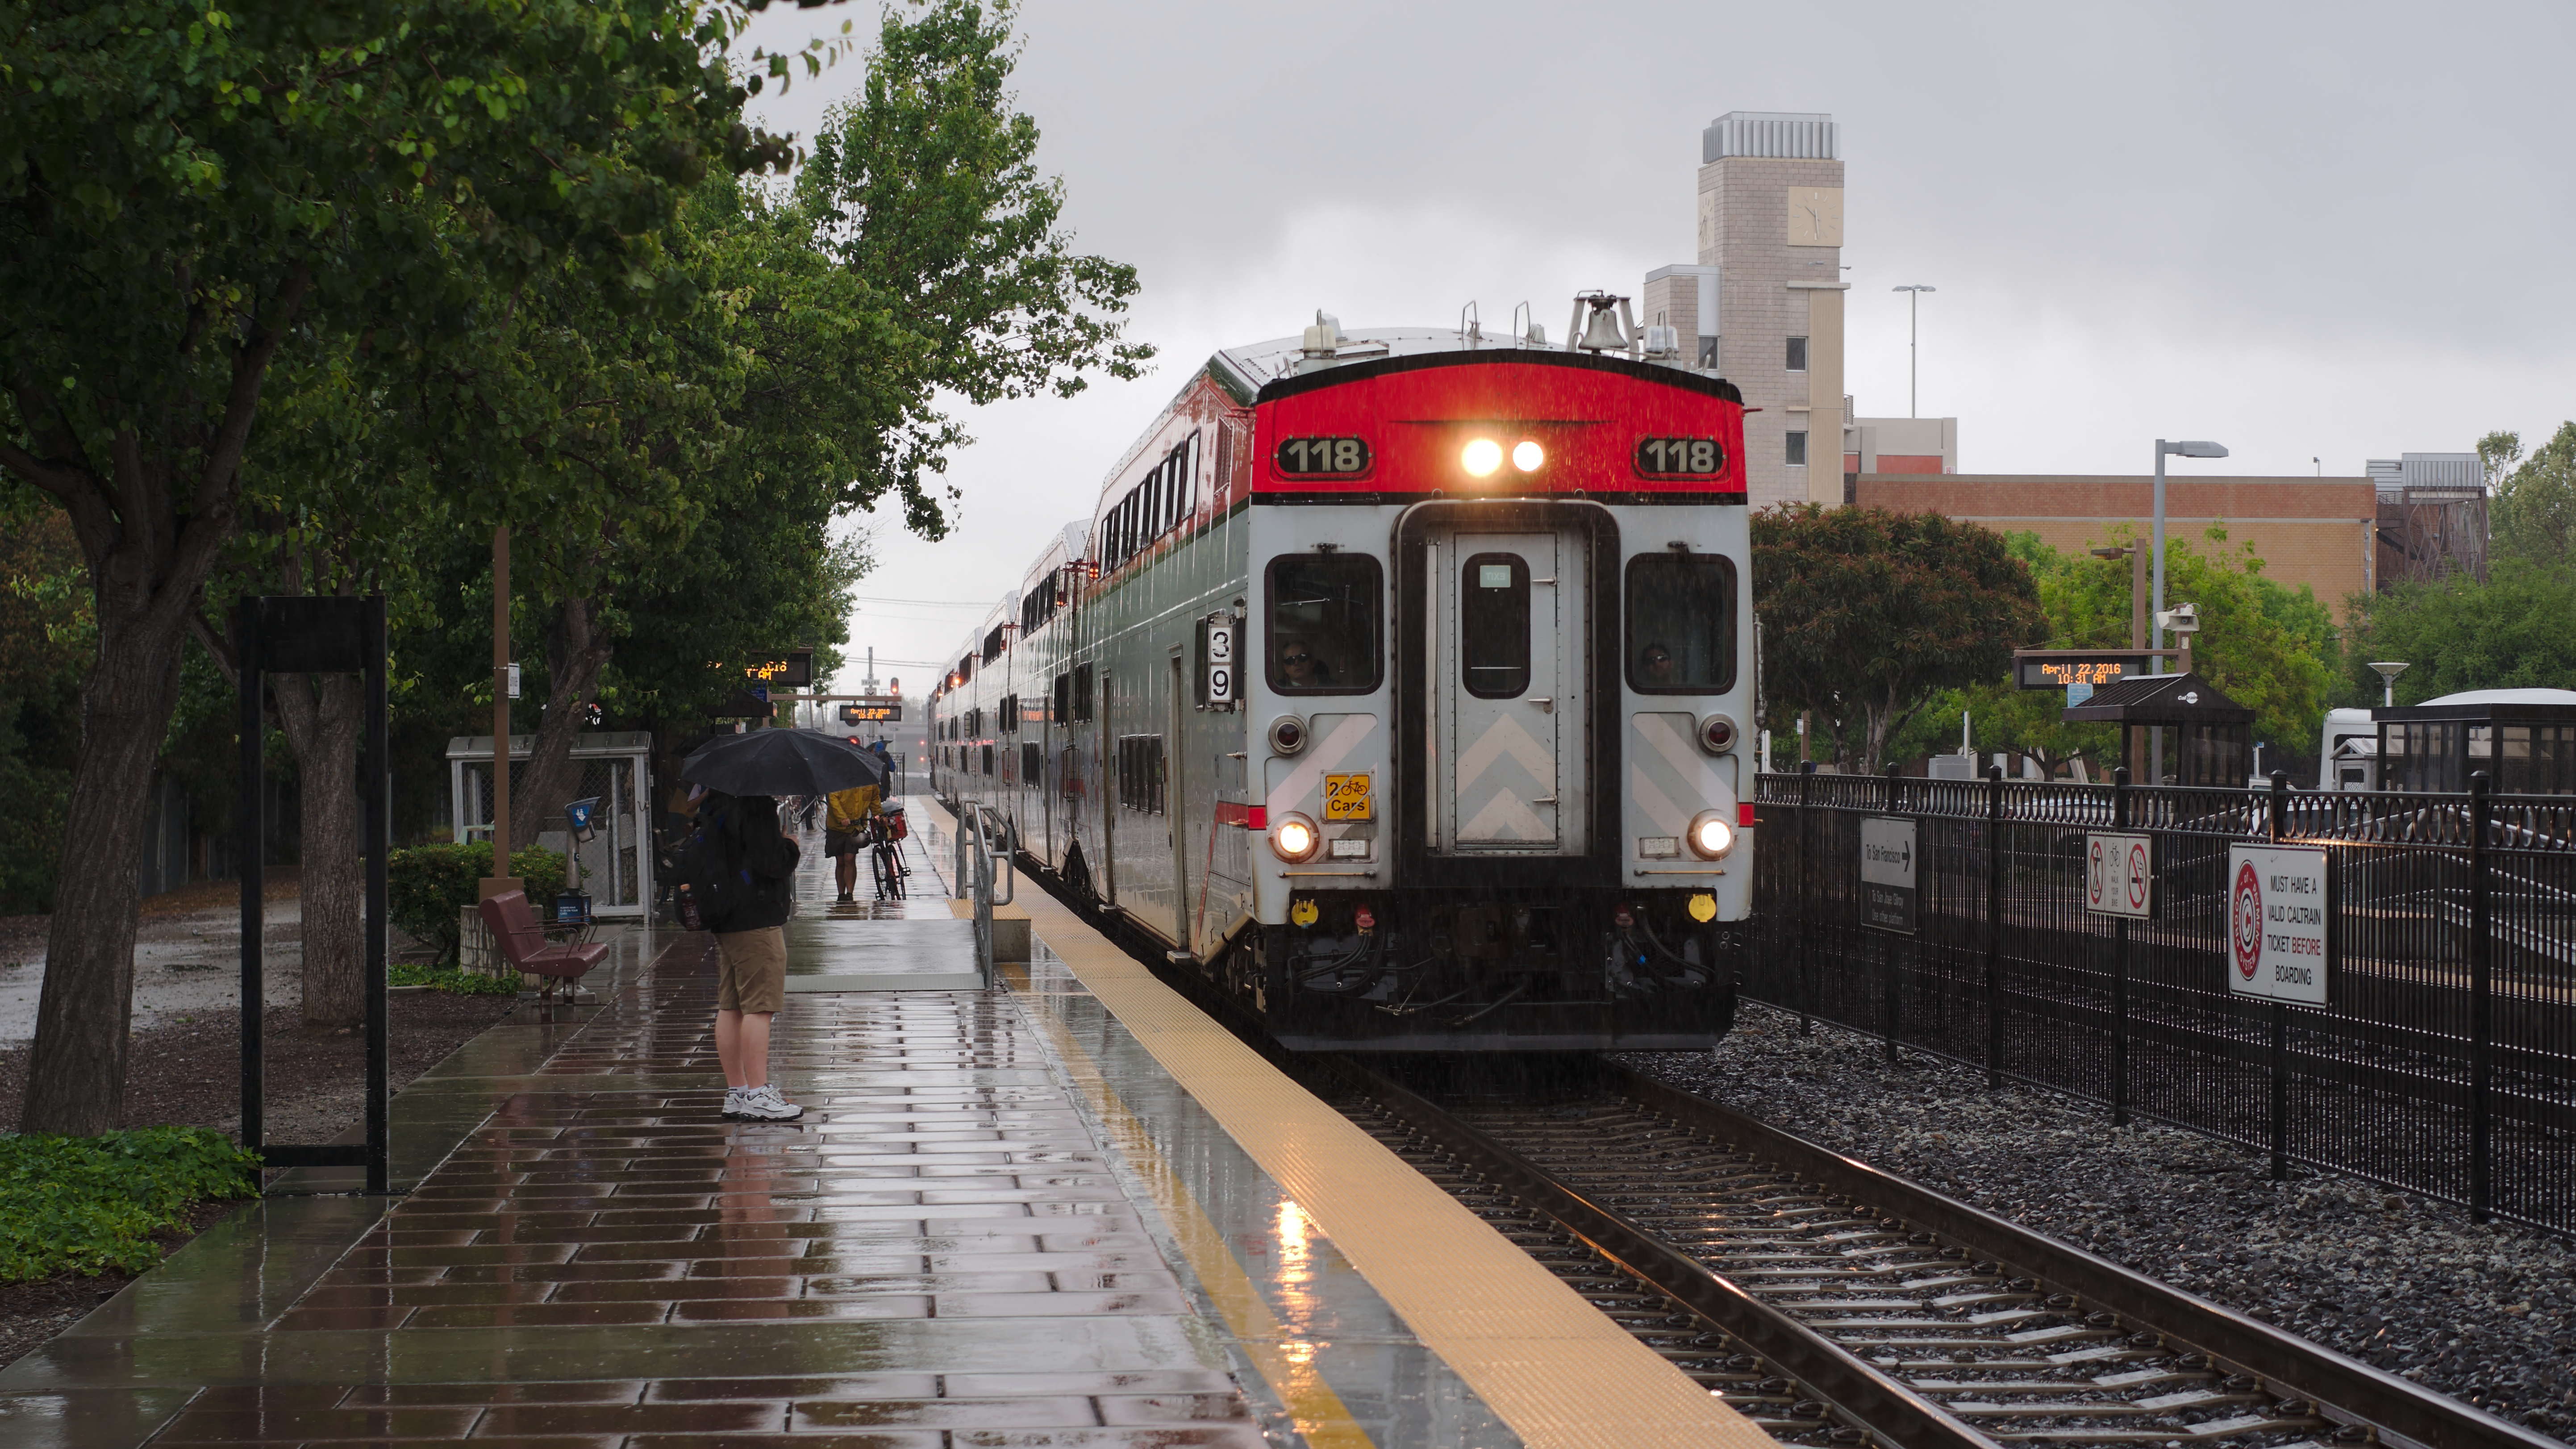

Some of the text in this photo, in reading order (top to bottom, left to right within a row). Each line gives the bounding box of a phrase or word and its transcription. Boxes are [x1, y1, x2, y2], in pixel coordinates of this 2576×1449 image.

[1287, 440, 1359, 472] 118
[1646, 440, 1714, 472] 118
[2042, 664, 2121, 674] April 22,2016
[2058, 673, 2106, 685] 10:31 AM
[1330, 782, 1339, 796] 2
[1331, 799, 1365, 811] Cars
[1866, 844, 1871, 860] To
[1881, 846, 1900, 864] Francisco
[2271, 875, 2317, 894] MUST HAVE A
[1872, 889, 1876, 902] To
[1880, 910, 1888, 923] other
[1888, 911, 1903, 926] platform
[2268, 905, 2321, 925] VALID CALTRAIN
[2268, 934, 2321, 956] TICKET BEFORE
[2239, 951, 2256, 971] SYSTEM
[2276, 965, 2312, 985] BOARDING
